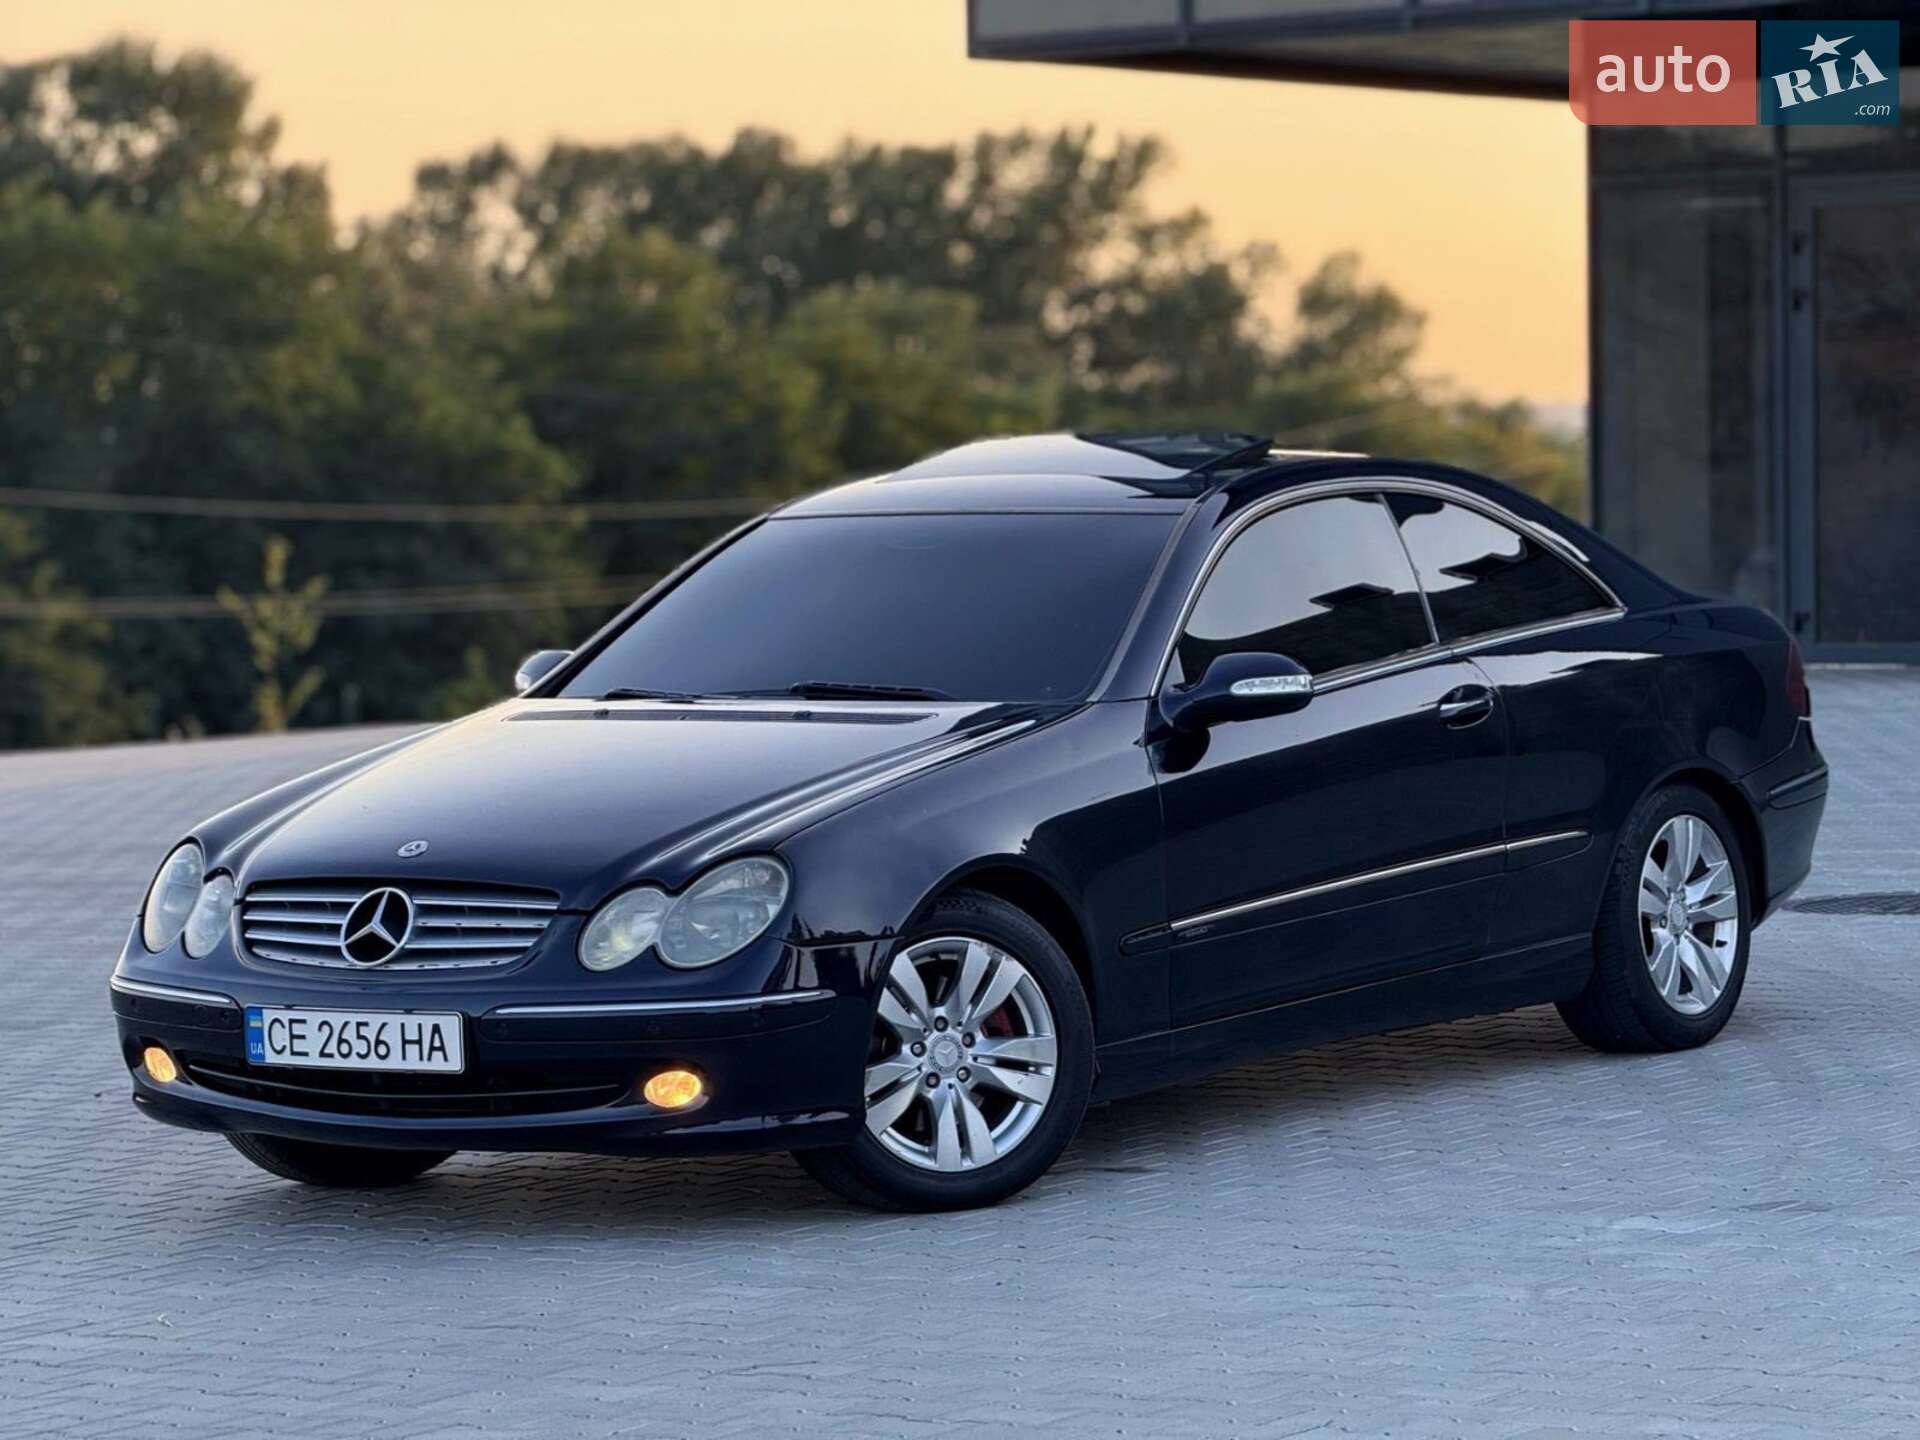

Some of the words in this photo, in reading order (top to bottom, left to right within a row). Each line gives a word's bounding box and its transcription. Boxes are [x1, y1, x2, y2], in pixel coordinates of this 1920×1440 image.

[250, 1042, 264, 1055] UA
[267, 1017, 309, 1057] CE
[317, 1020, 391, 1060] 2656
[400, 1022, 449, 1062] HA
